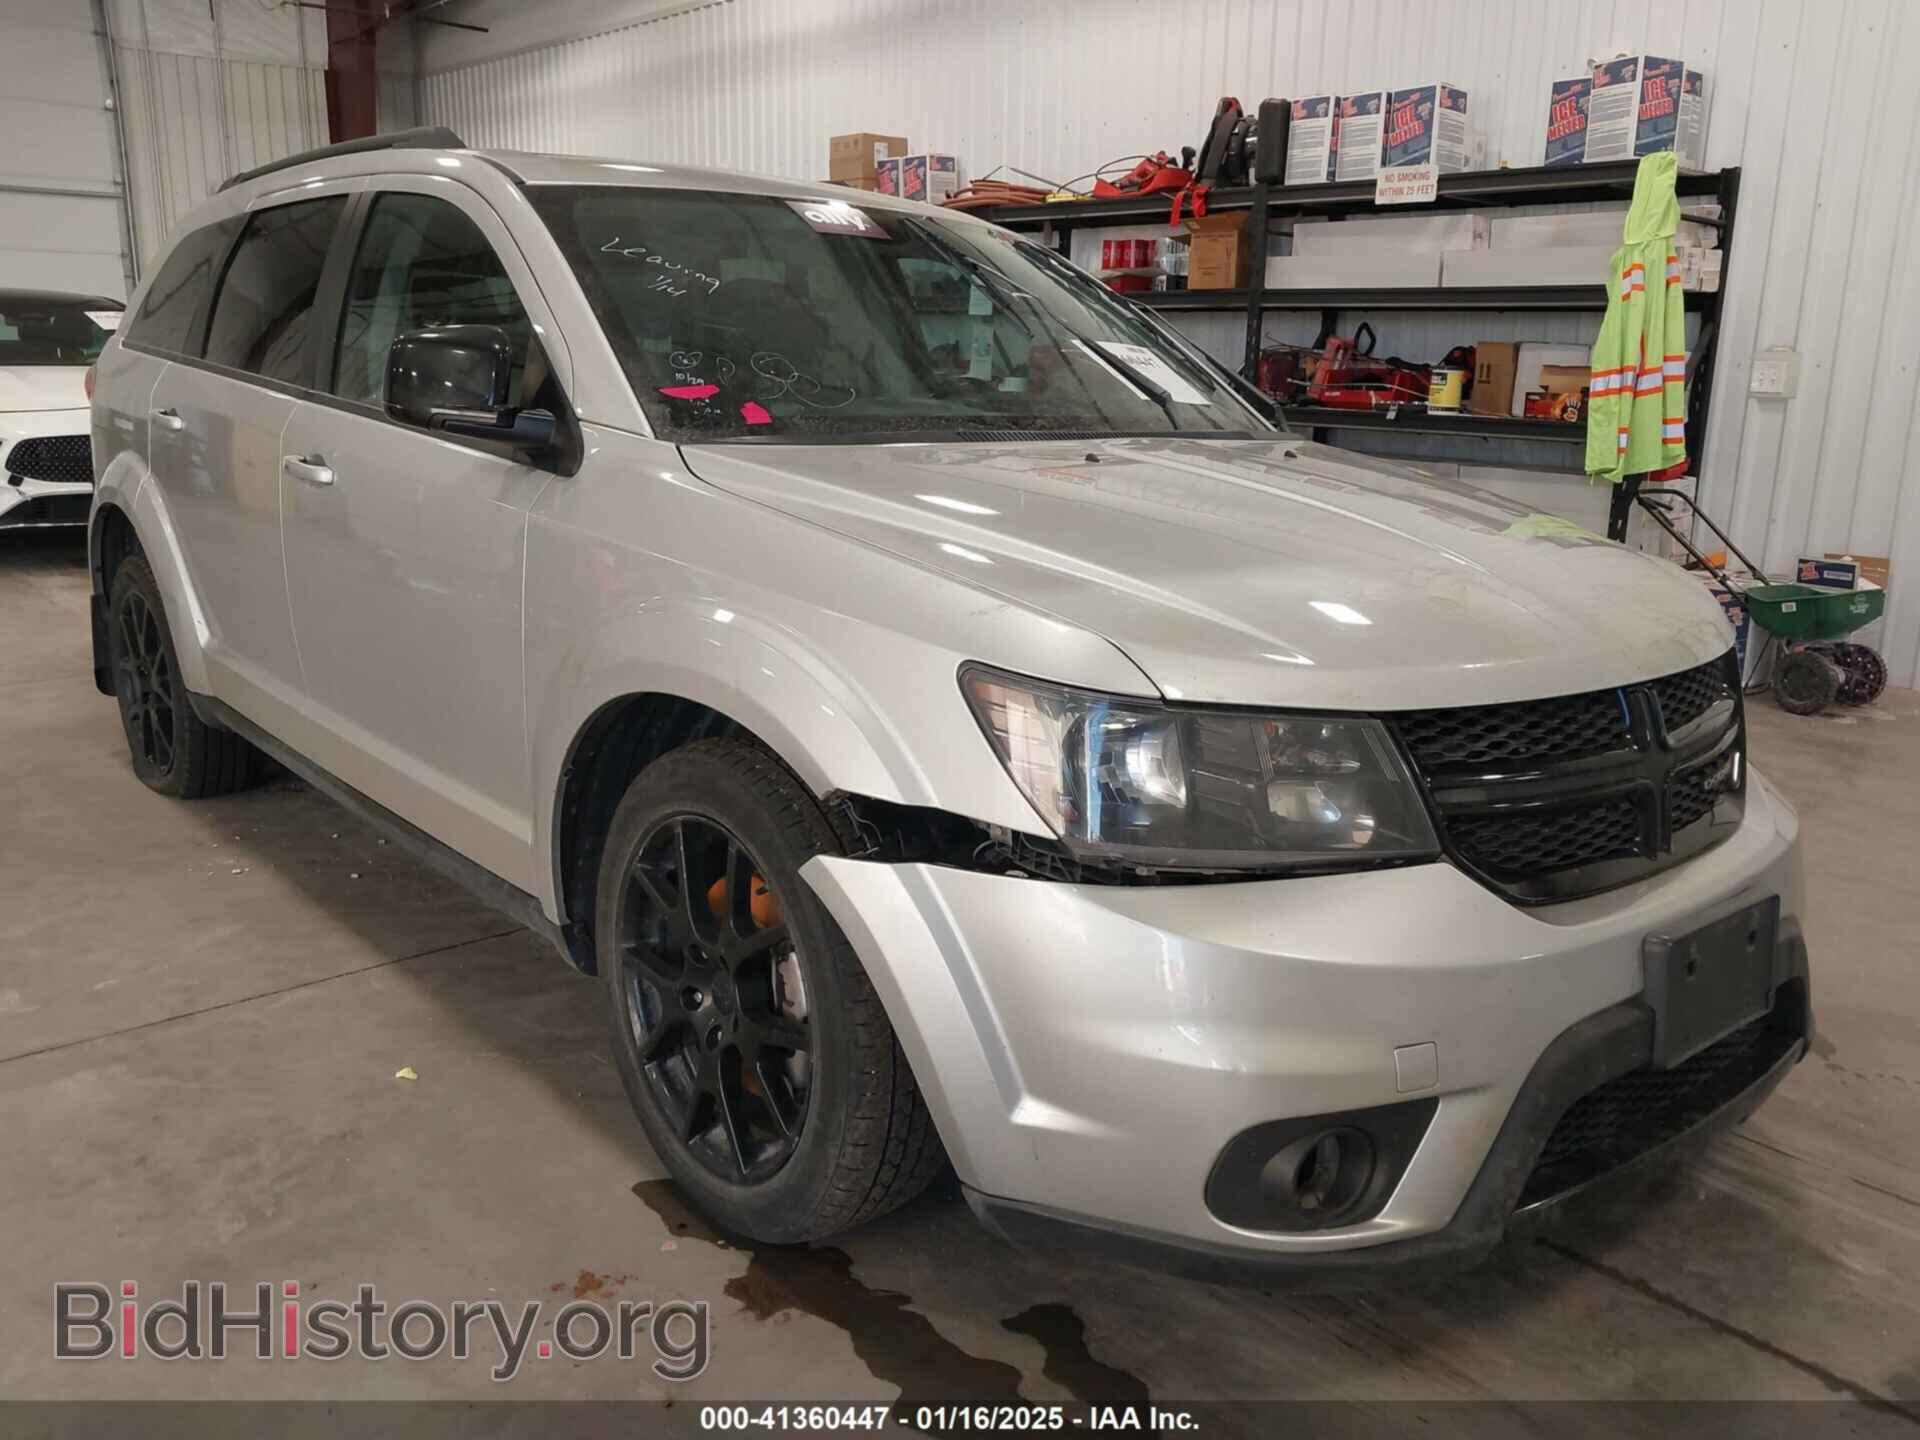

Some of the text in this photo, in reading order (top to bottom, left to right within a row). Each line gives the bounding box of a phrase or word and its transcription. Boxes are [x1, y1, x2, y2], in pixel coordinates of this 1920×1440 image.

[1643, 76, 1665, 104] ICE
[1394, 105, 1416, 132] ICE
[1551, 96, 1577, 126] ICE
[1639, 97, 1674, 120] MELTER
[1547, 114, 1585, 141] MELTER
[1384, 170, 1431, 183] NO SMOKING
[1378, 184, 1435, 197] WITHIN 25 FEET
[803, 205, 867, 231] ally
[600, 237, 720, 295] Leaving
